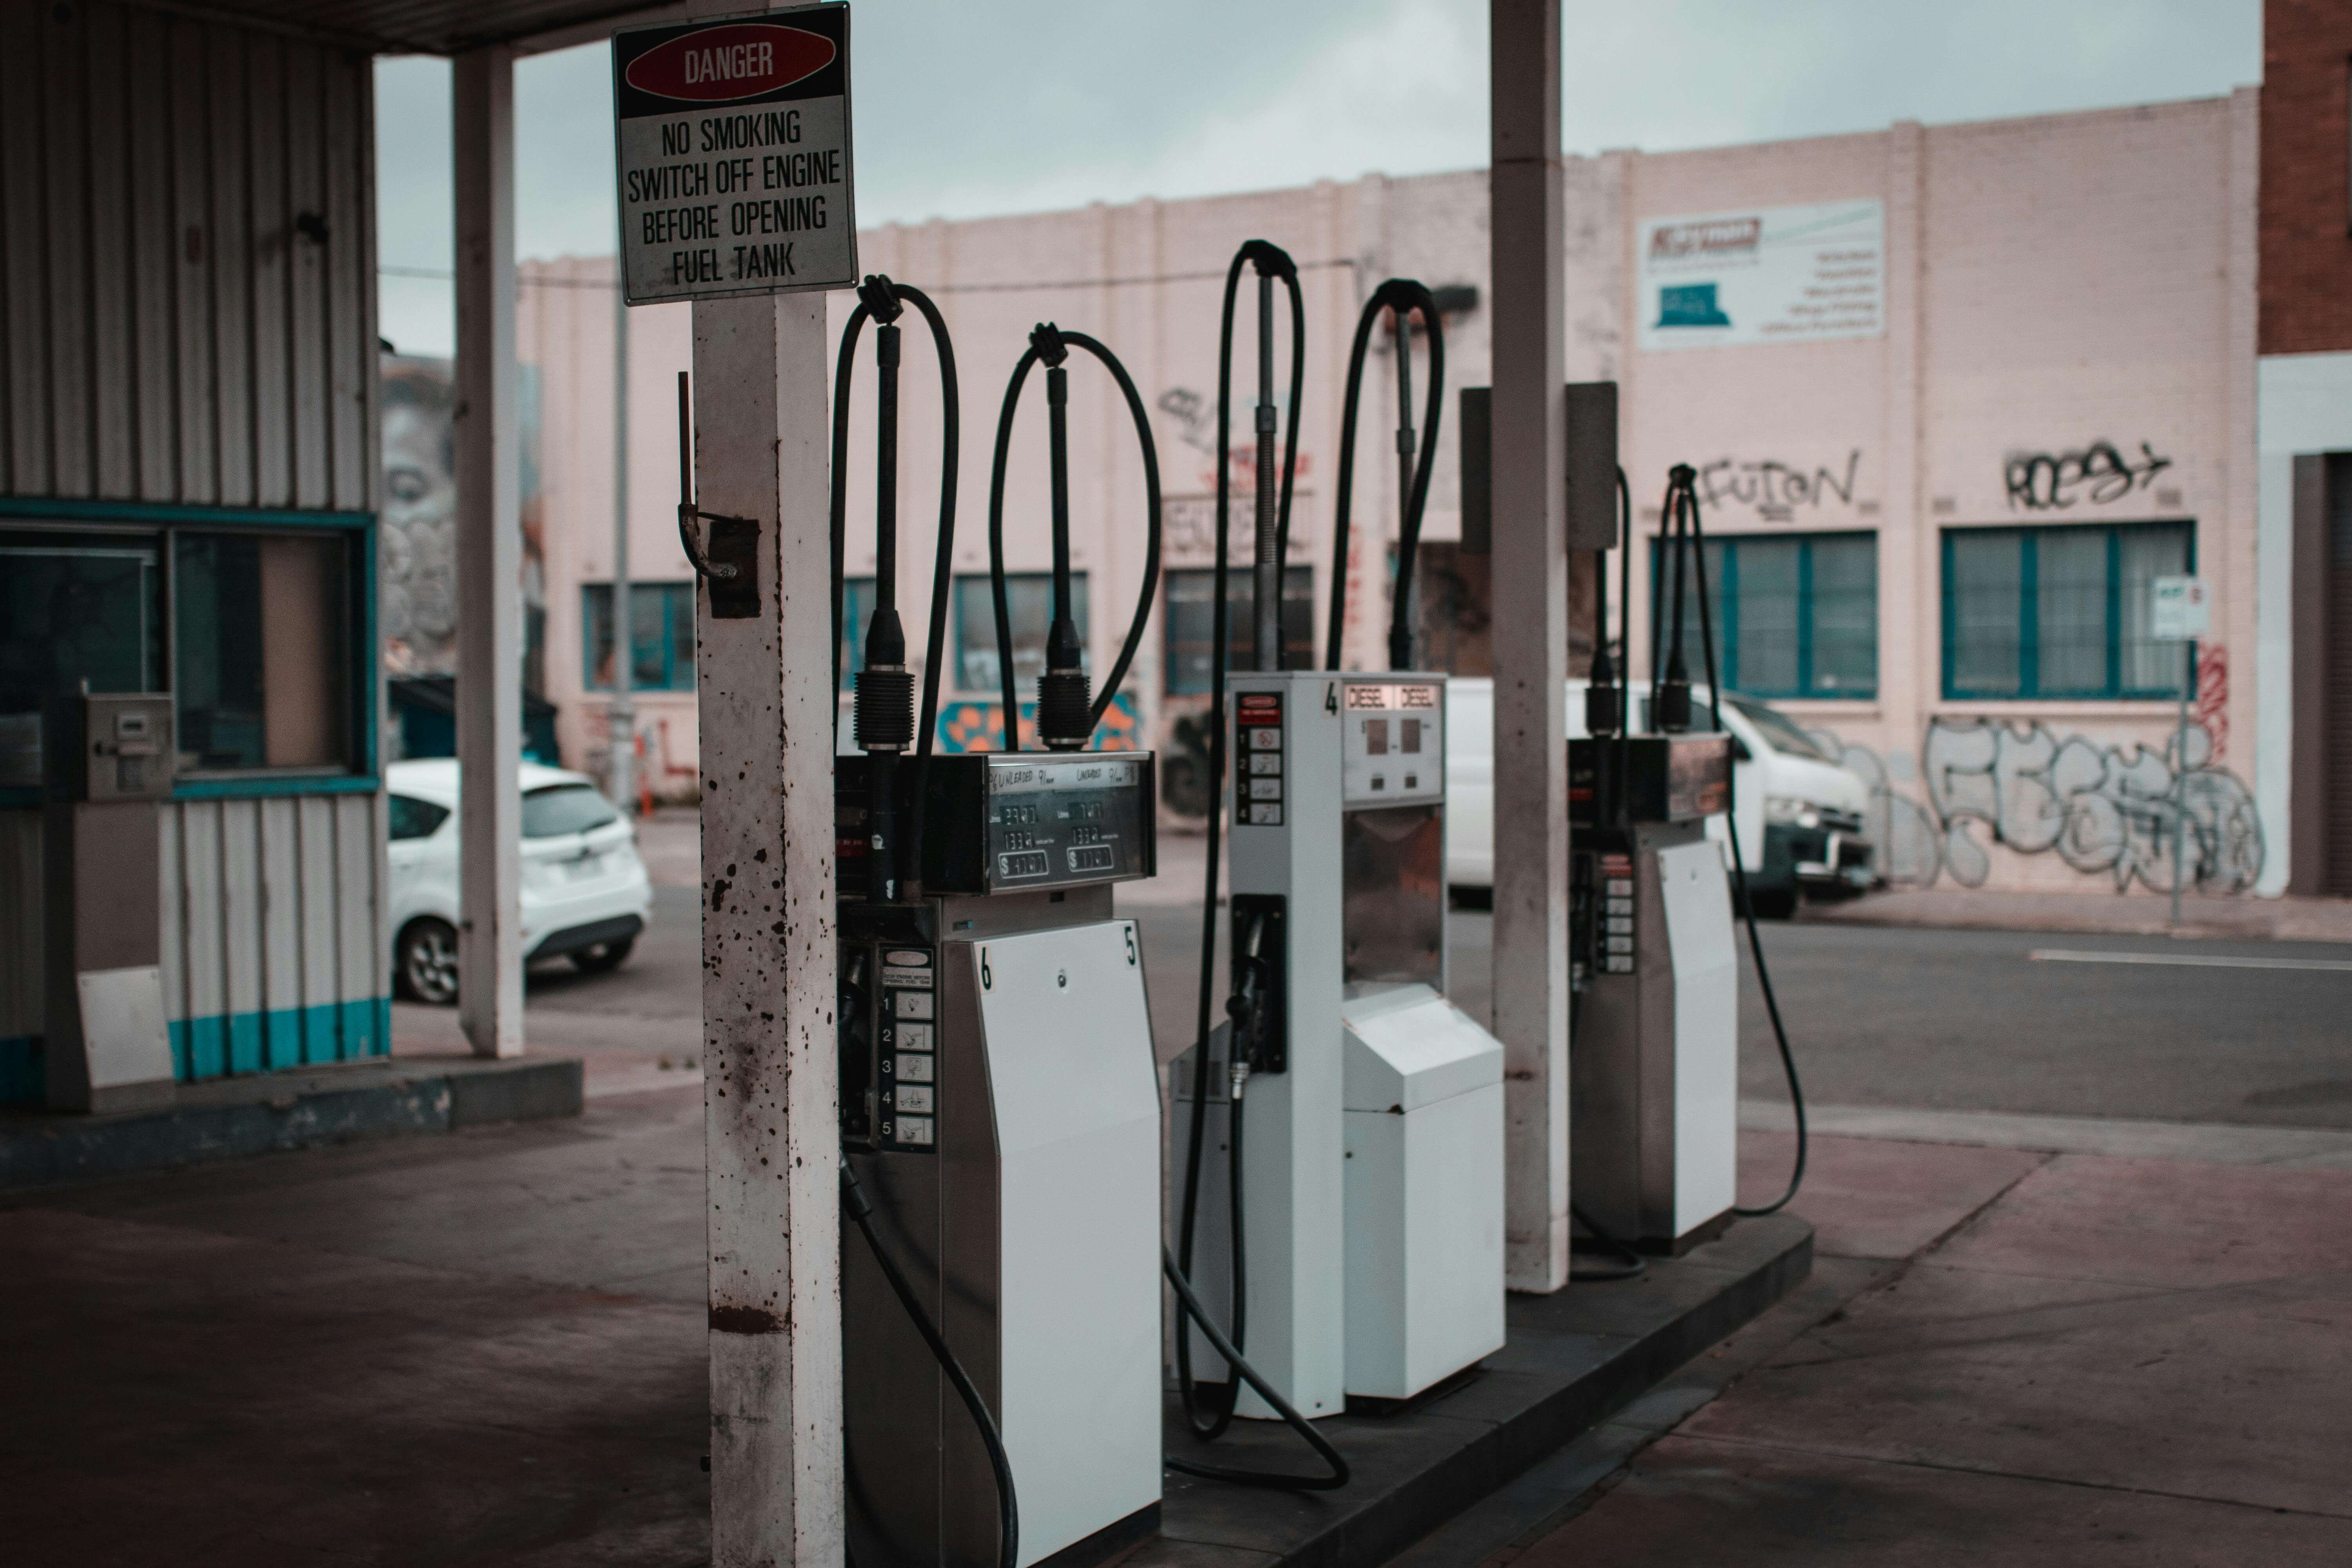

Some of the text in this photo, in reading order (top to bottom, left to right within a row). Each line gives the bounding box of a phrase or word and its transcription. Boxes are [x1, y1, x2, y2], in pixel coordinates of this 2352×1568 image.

[685, 42, 773, 84] DANGER
[662, 110, 800, 156] NO SMOKING
[628, 149, 840, 203] SWITCH OFF ENGINE
[642, 196, 826, 245] BEFORE OPENING
[673, 242, 796, 285] FUEL TANK
[1326, 681, 1337, 716] 4
[1239, 760, 1247, 769] 2
[1239, 784, 1247, 793] 3
[1124, 926, 1135, 965] 5
[982, 947, 991, 990] 6
[883, 998, 889, 1010] 1
[883, 1029, 891, 1042] 2
[882, 1060, 891, 1073] 3
[882, 1092, 891, 1104] 4
[882, 1122, 891, 1135] 5
